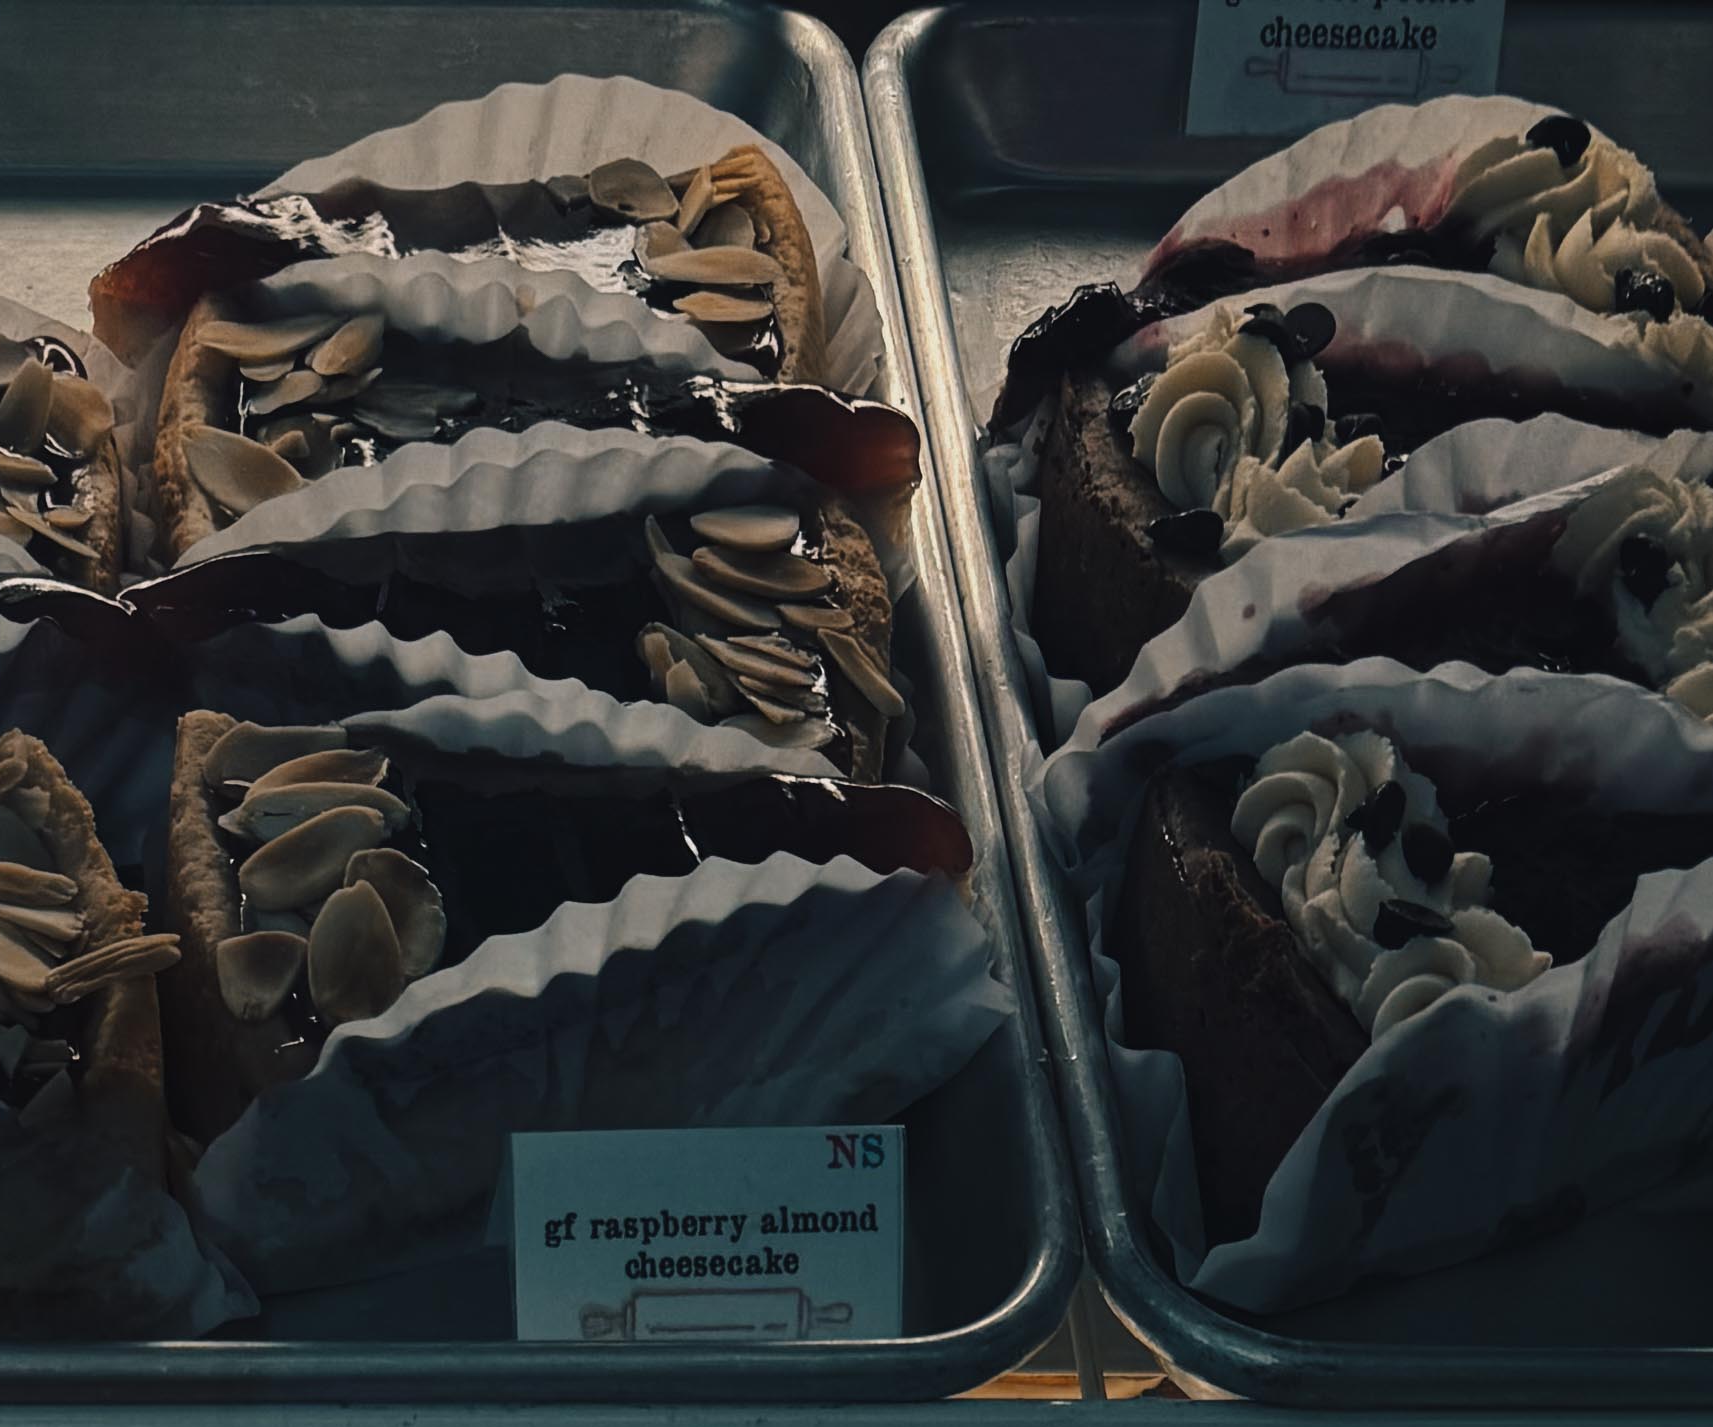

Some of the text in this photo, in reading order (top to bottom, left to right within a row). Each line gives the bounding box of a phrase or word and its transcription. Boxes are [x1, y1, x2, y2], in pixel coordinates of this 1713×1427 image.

[1259, 16, 1438, 49] cheesecake
[825, 1133, 886, 1169] NS
[544, 1203, 880, 1248] gf raspberry almond
[625, 1247, 801, 1280] cheesecake
